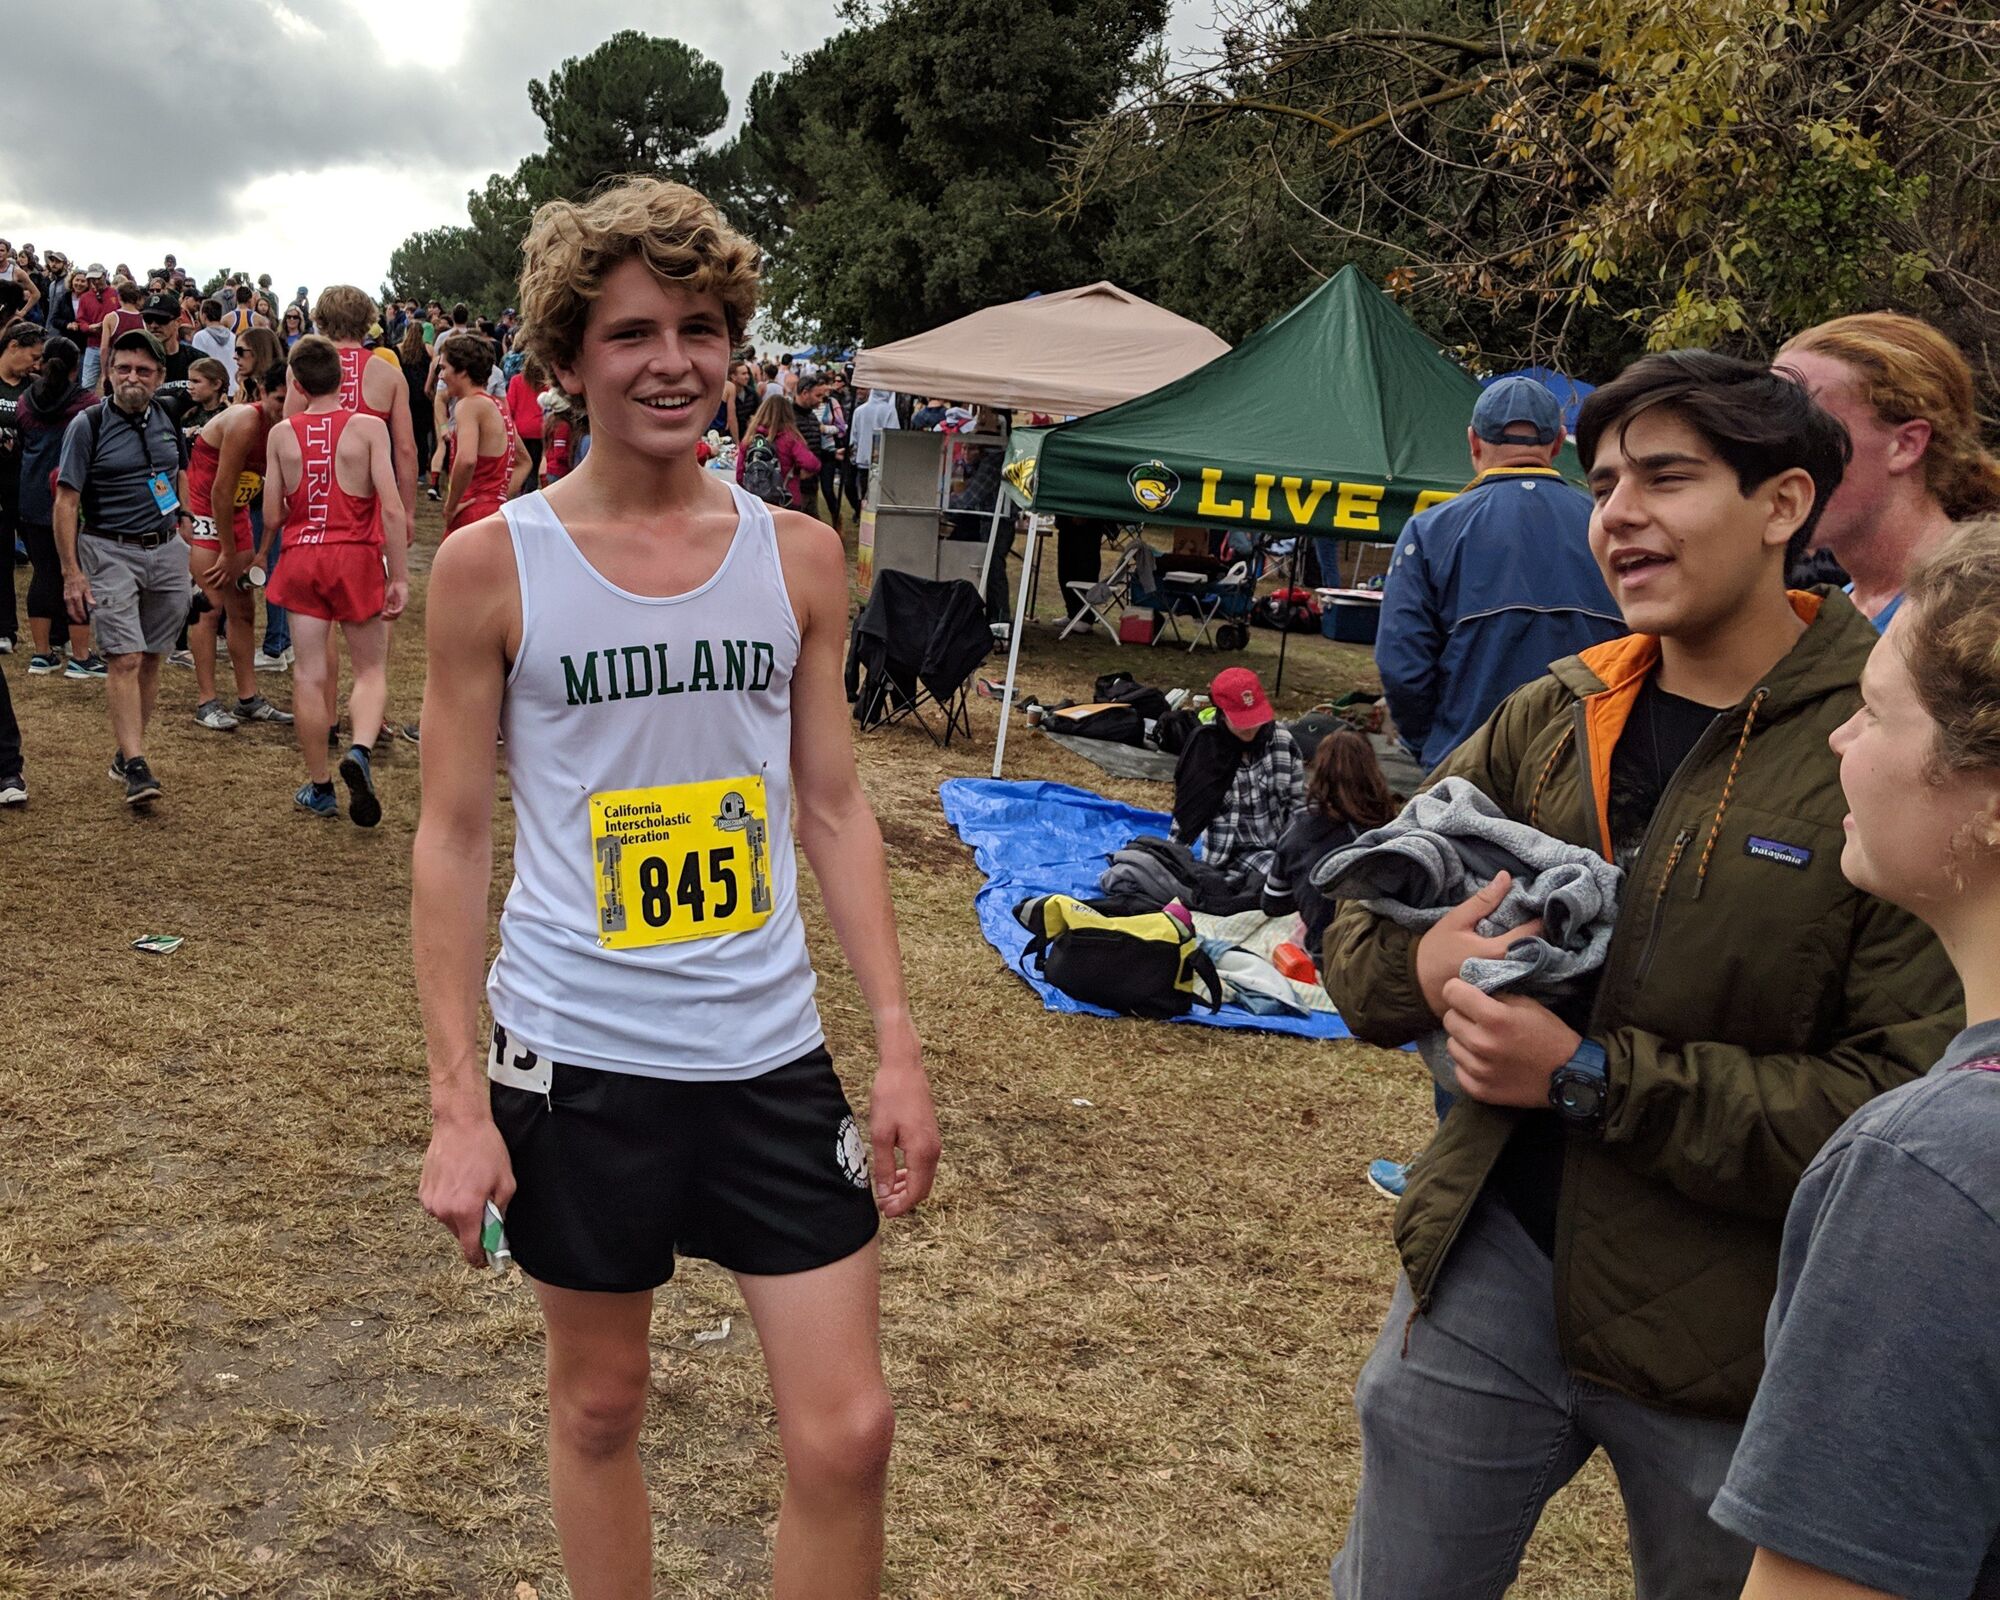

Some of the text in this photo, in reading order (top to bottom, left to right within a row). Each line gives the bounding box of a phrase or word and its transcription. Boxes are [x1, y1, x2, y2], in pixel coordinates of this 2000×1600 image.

[1197, 467, 1386, 531] LIVE
[560, 640, 775, 706] MIDLAND
[604, 801, 662, 818] California
[605, 812, 692, 833] Interscholastic
[607, 830, 670, 845] deration
[1751, 846, 1802, 864] patagonia
[639, 847, 737, 927] 845
